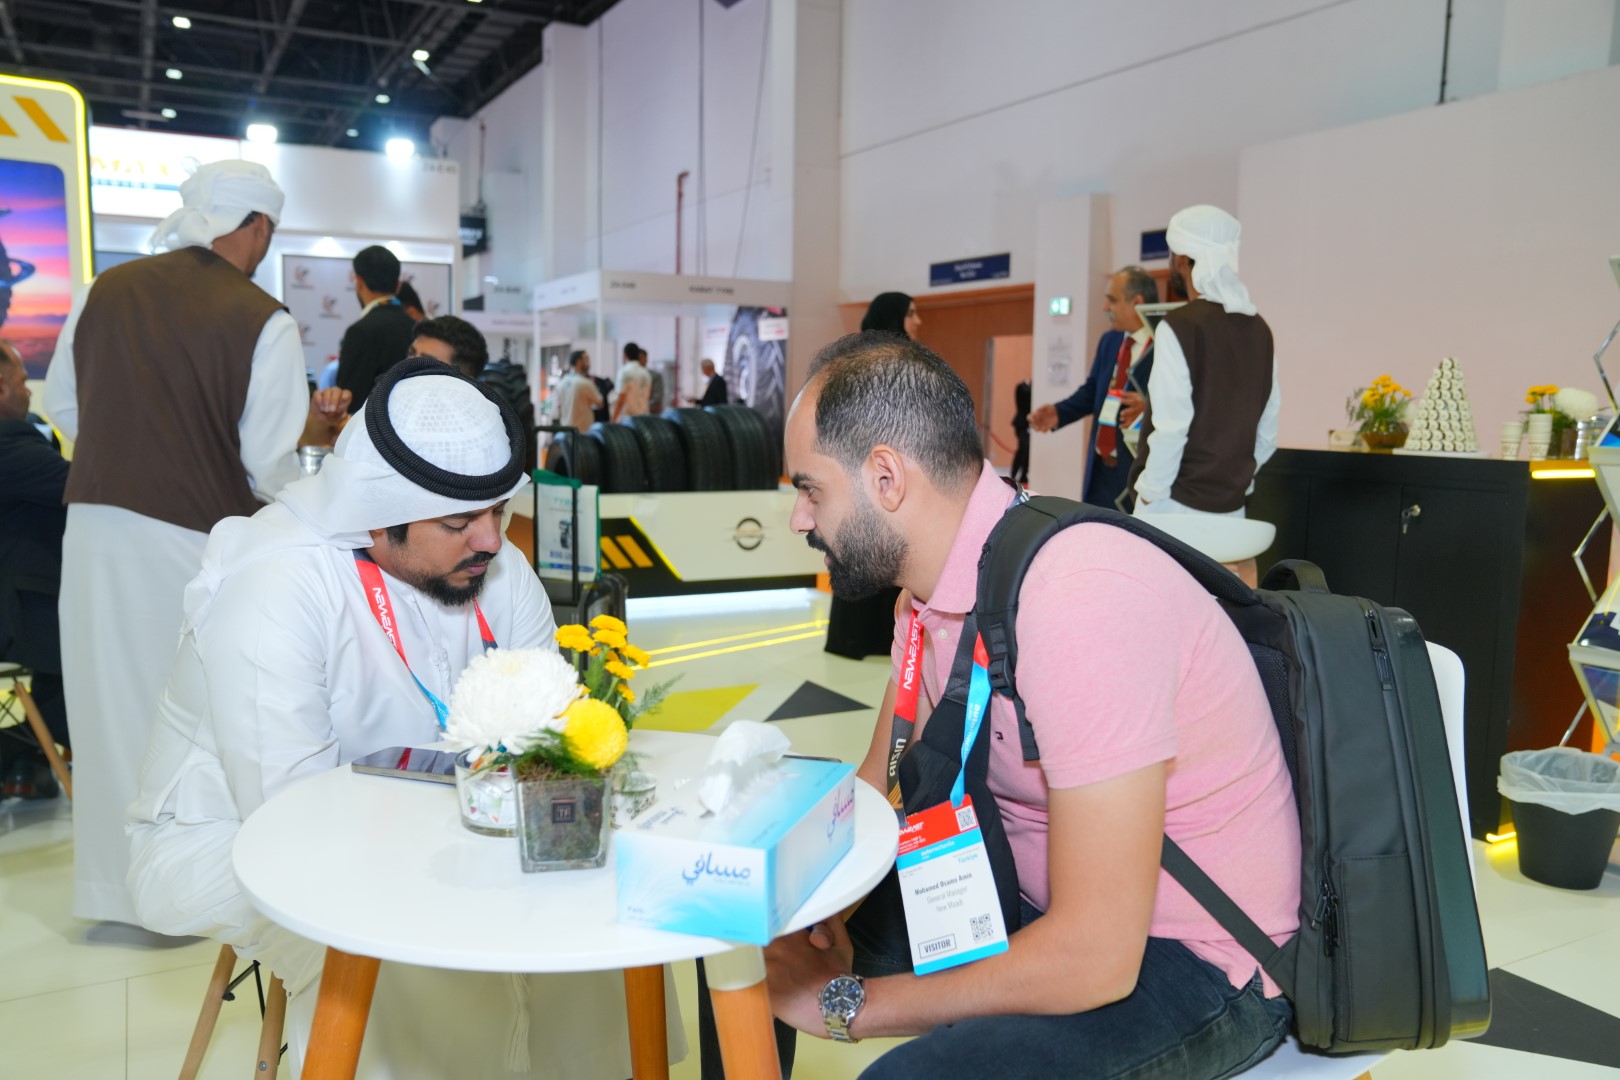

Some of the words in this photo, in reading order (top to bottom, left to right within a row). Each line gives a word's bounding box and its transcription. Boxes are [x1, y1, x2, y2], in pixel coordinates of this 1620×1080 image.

[903, 619, 920, 690] NEWEAST
[682, 851, 751, 885] مسافي
[958, 872, 973, 882] Amin
[924, 938, 951, 953] VISITOR
